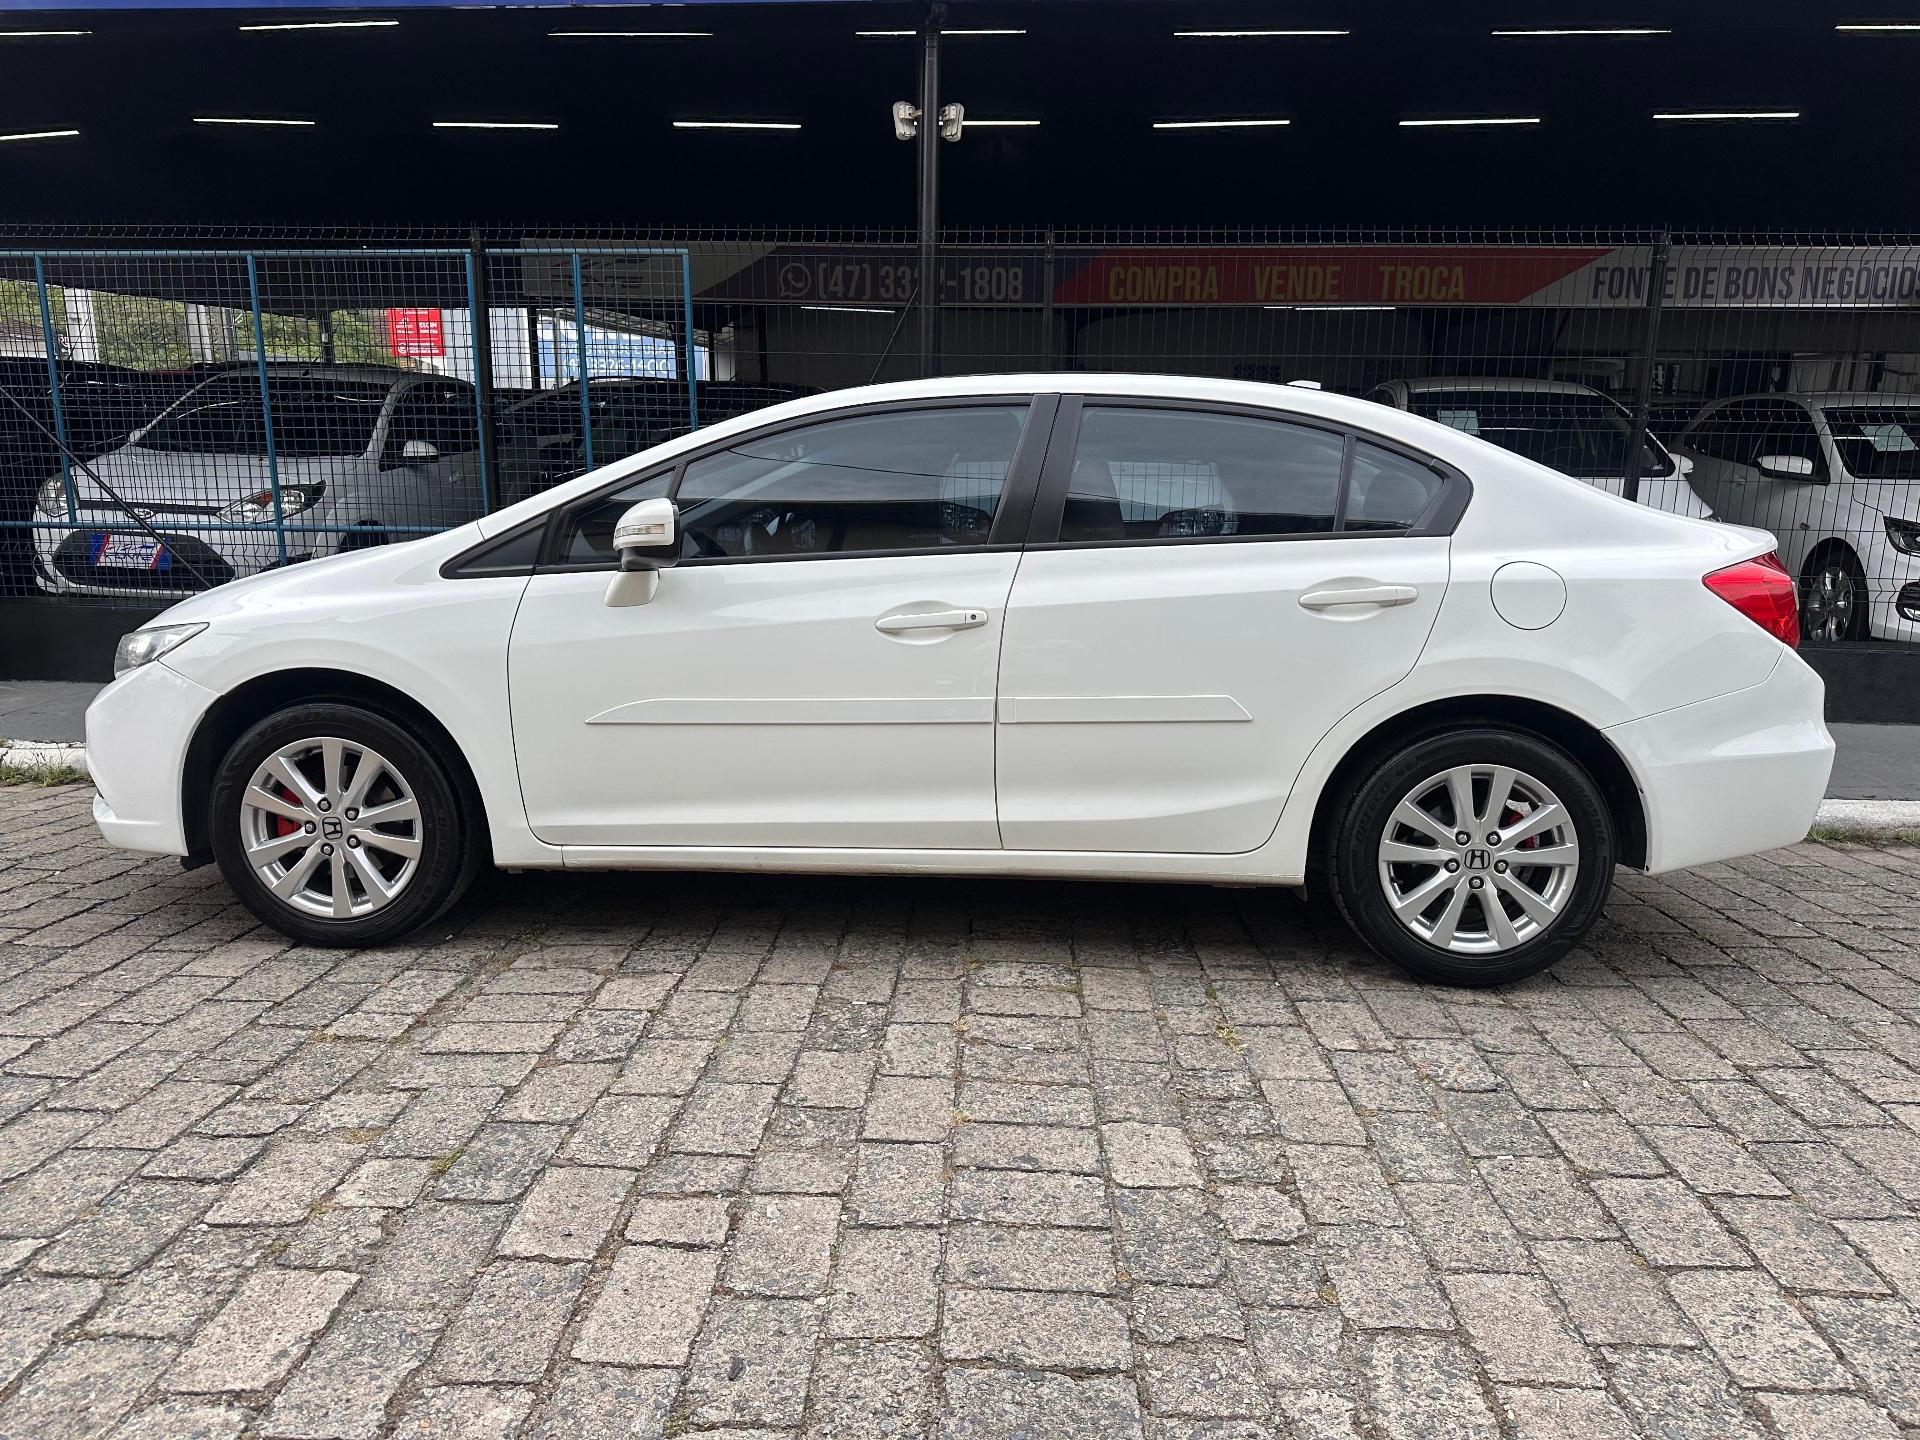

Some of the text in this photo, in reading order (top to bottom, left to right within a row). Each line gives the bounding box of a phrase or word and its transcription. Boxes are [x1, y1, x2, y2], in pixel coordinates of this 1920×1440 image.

[817, 262, 871, 300] (47)
[1109, 264, 1465, 300] COMPRA VENDE TROCA
[1682, 266, 1719, 299] DE
[1724, 266, 1796, 299] BONS
